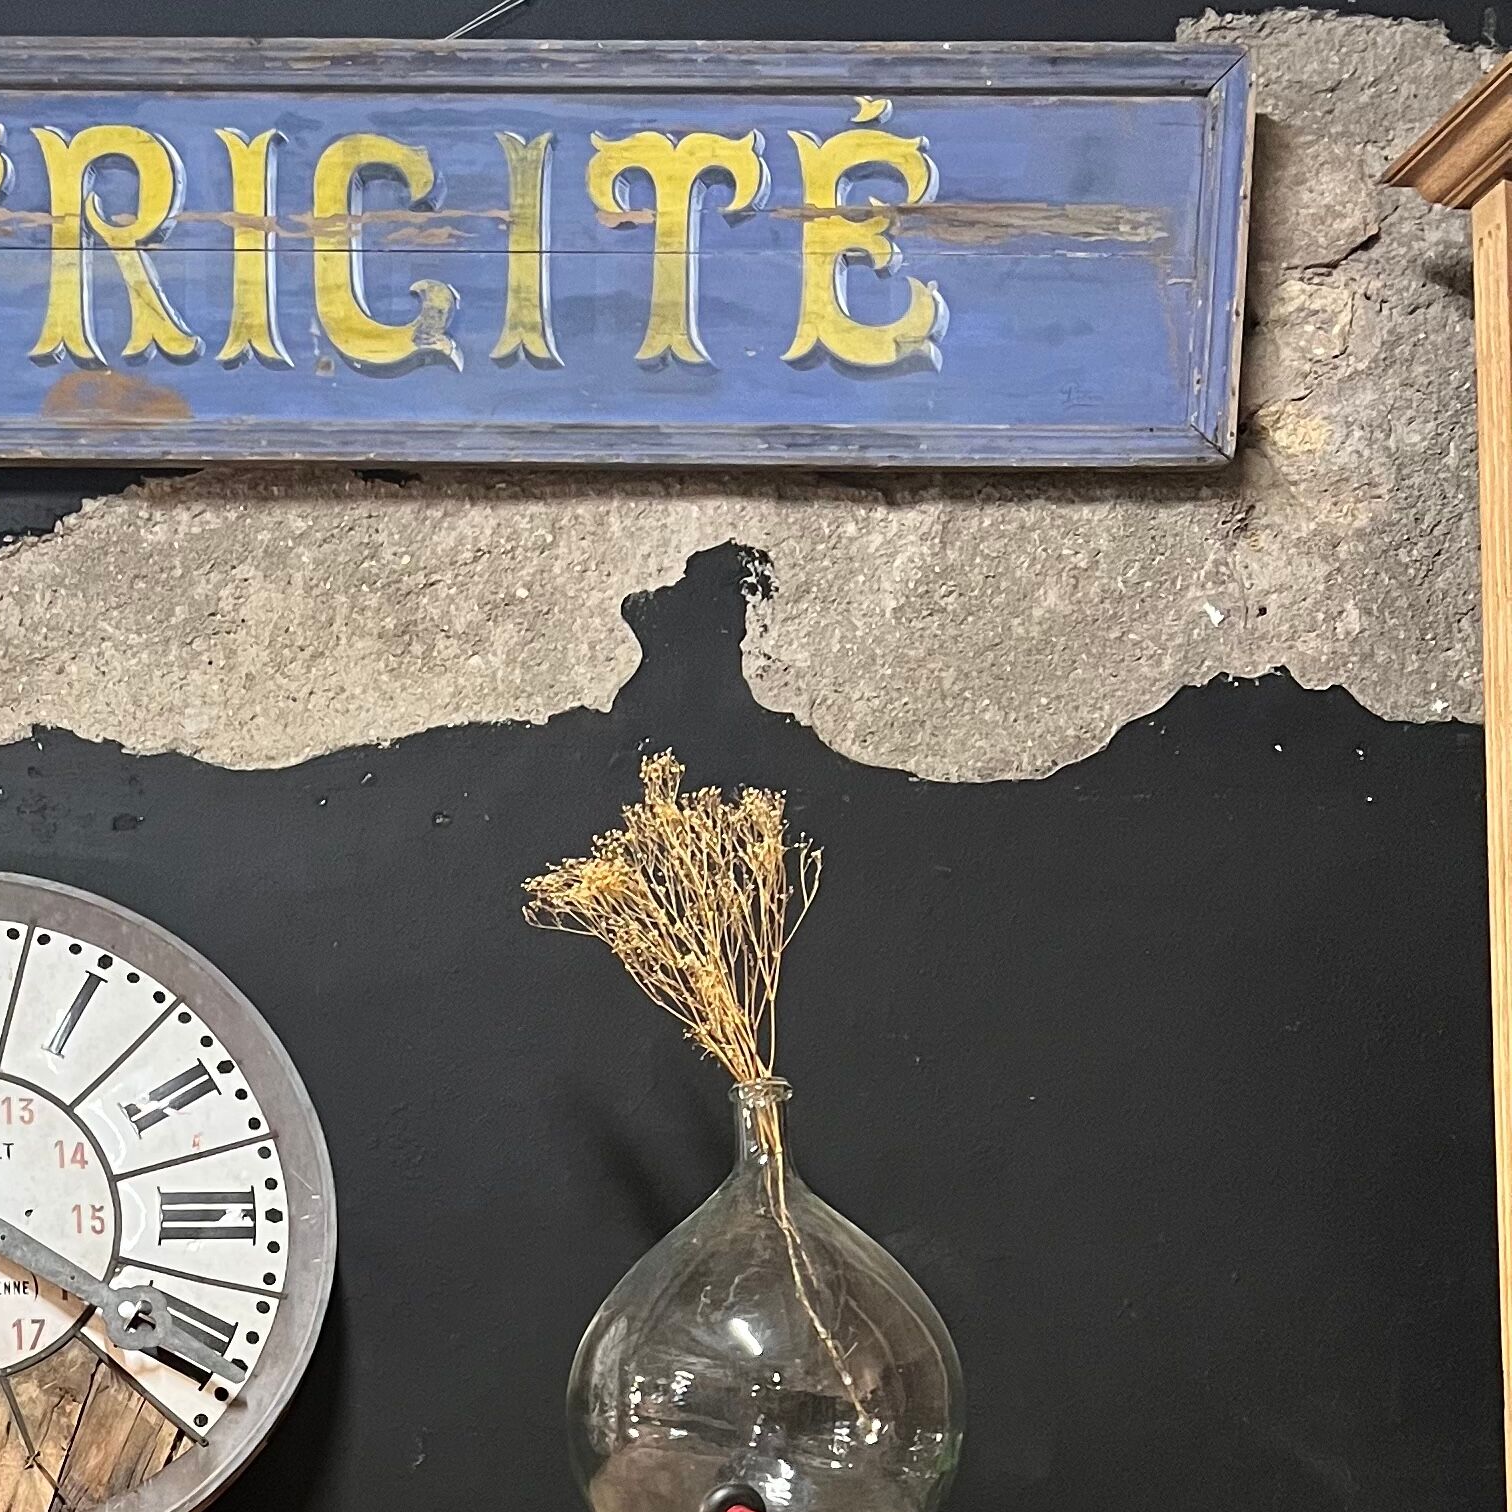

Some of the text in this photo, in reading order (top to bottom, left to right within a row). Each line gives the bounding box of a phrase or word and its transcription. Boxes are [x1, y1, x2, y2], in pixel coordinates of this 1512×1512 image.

[40, 970, 109, 1060] I
[0, 1096, 36, 1126] 13
[116, 1057, 223, 1141] II
[54, 1139, 89, 1170] 14
[71, 1203, 106, 1236] 15
[156, 1185, 257, 1247] III
[10, 1318, 46, 1351] 17
